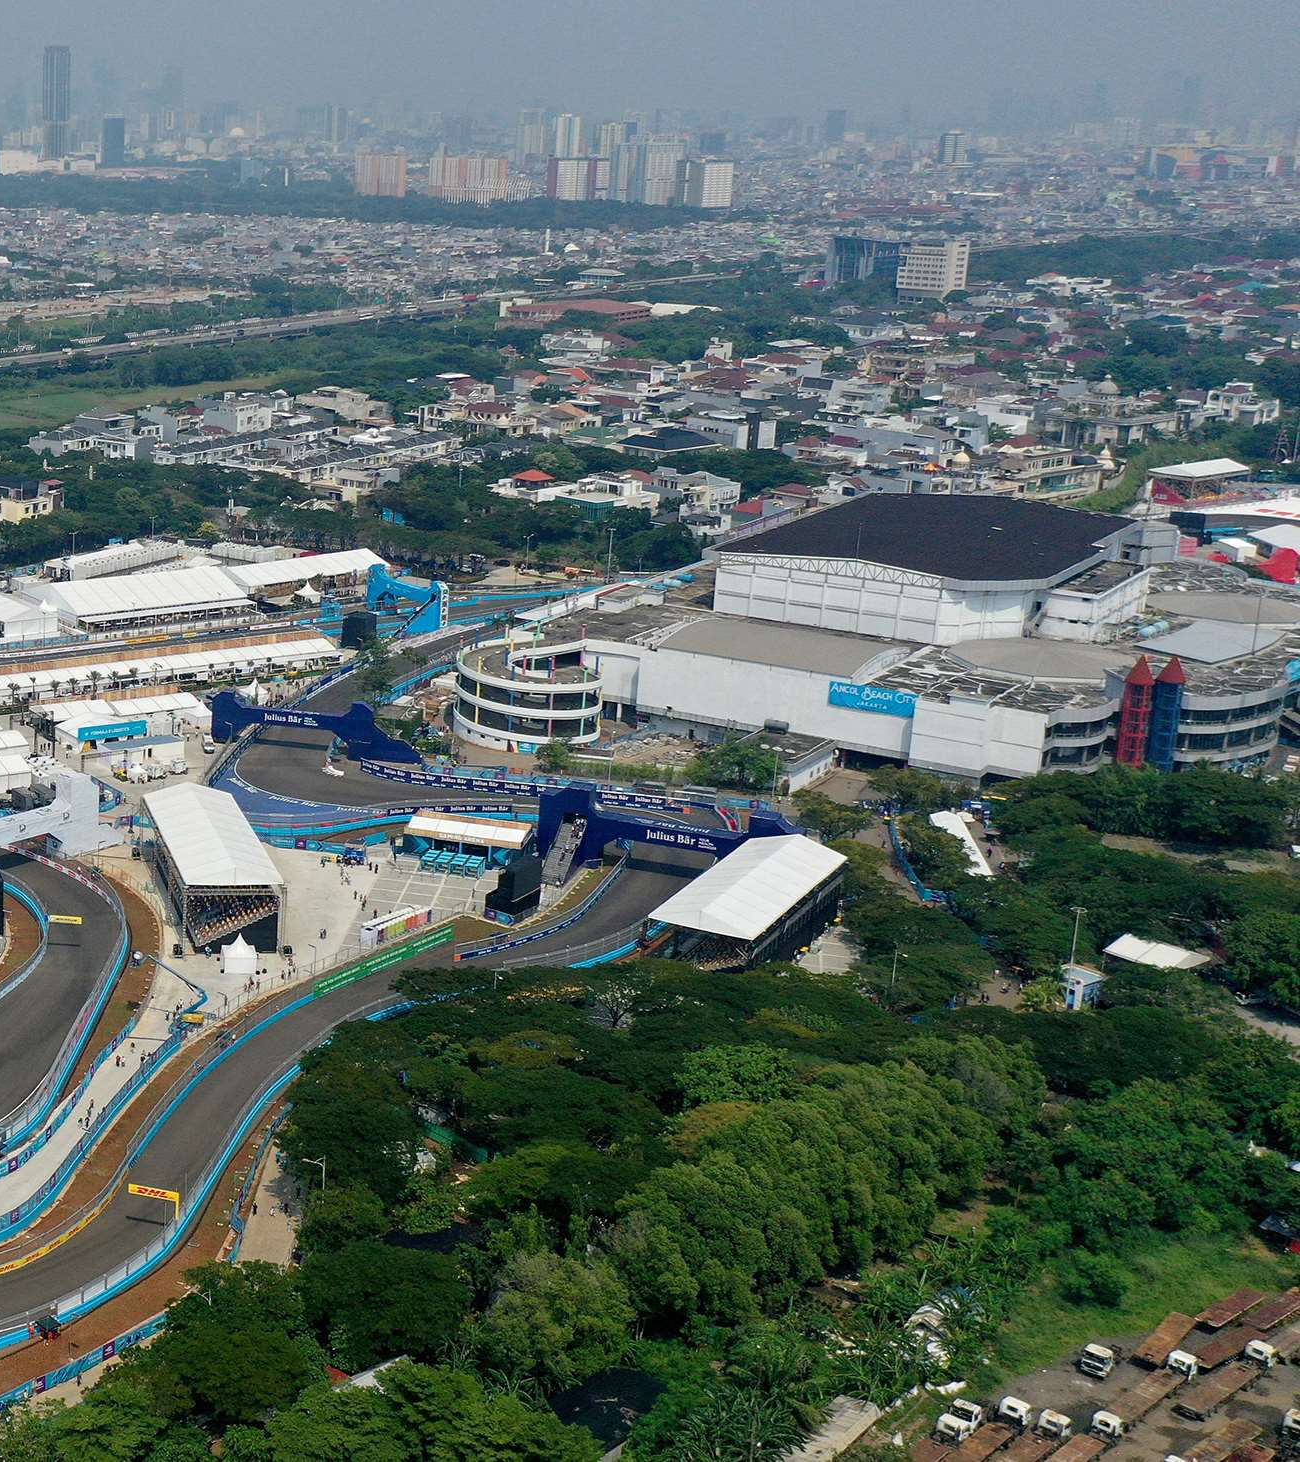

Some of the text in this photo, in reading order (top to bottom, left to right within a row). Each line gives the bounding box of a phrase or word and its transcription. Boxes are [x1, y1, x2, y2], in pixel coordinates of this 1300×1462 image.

[830, 682, 860, 695] ANCOL
[861, 687, 893, 700] BEACH
[857, 701, 888, 710] JAKARTA
[264, 713, 302, 724] Julius Bär
[410, 772, 425, 780] Julius
[390, 808, 404, 816] Julius
[646, 829, 696, 846] Julius Bär
[136, 1187, 169, 1199] DHL
